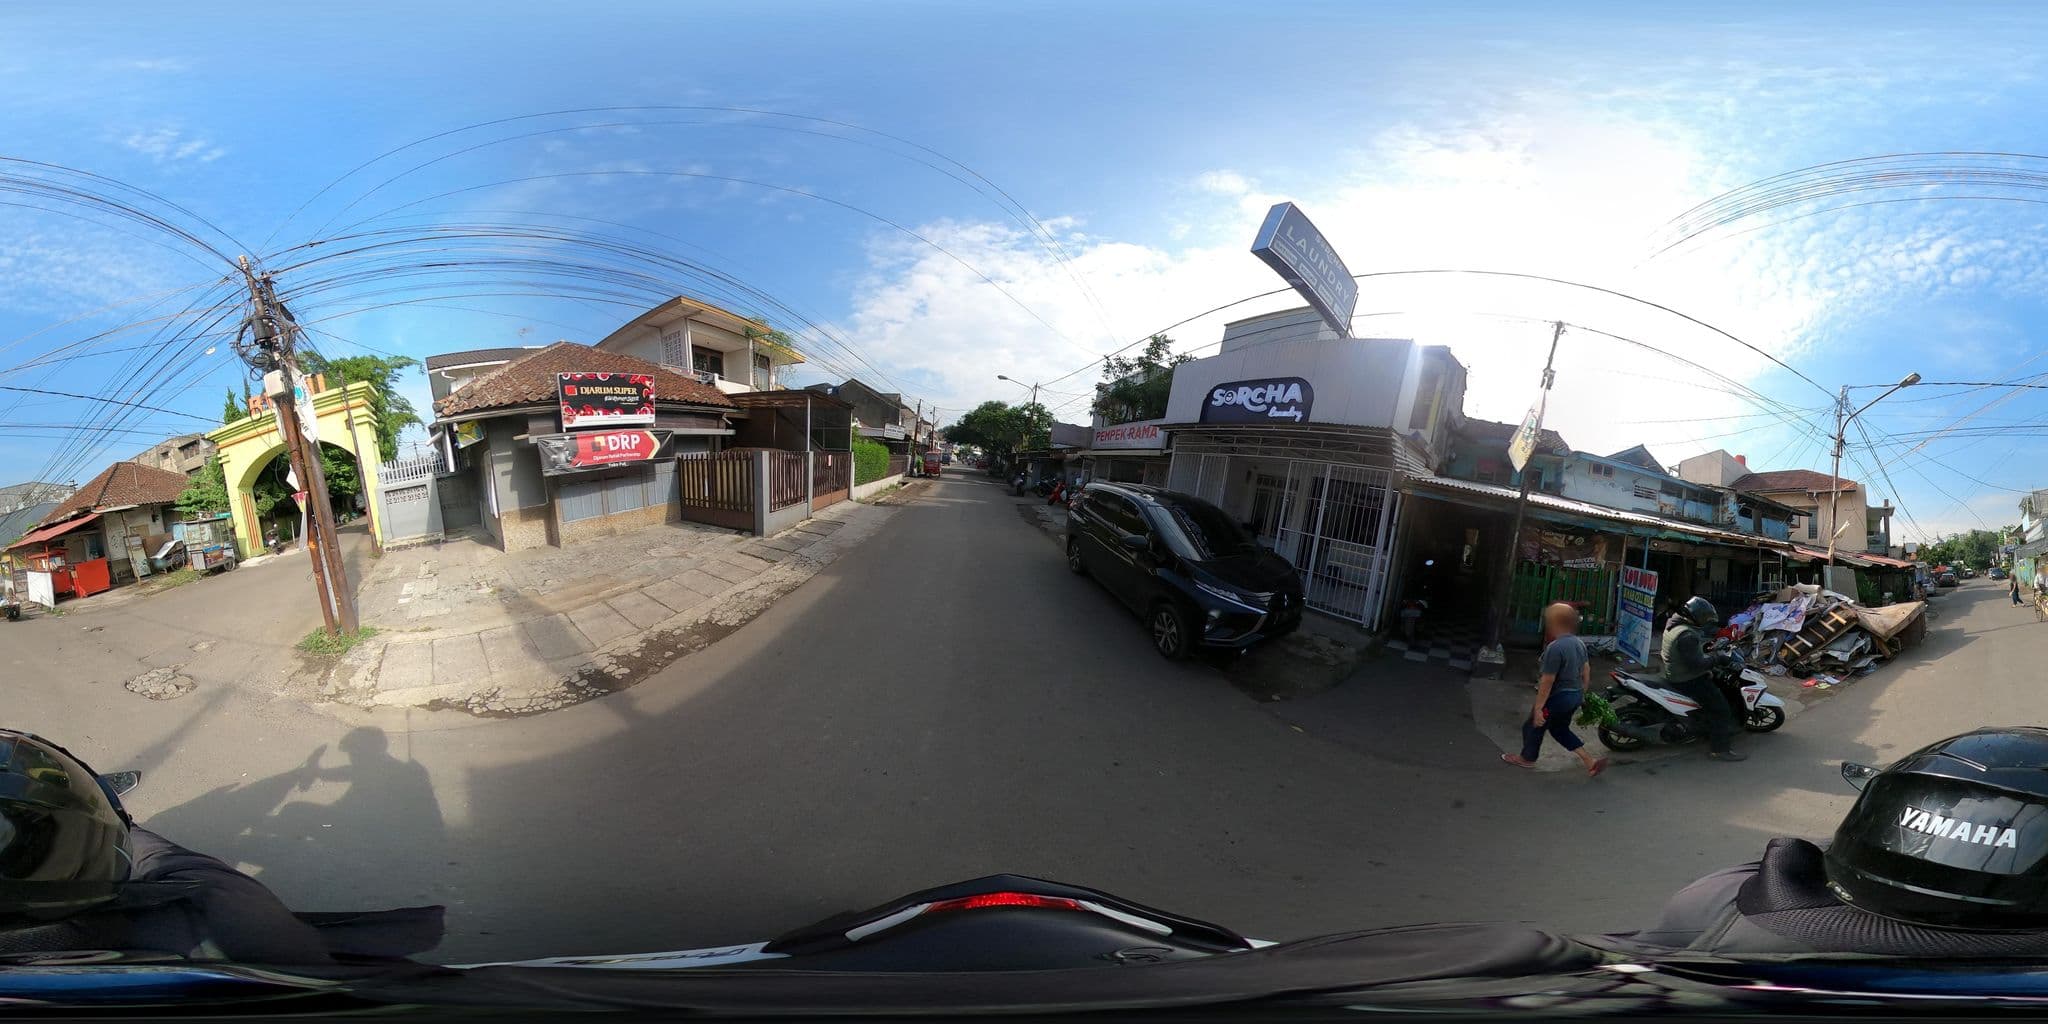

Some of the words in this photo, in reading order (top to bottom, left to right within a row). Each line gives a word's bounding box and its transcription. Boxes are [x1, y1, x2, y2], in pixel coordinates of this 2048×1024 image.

[1286, 225, 1350, 301] LAUNDRY
[580, 386, 613, 395] DJARUM
[614, 387, 638, 395] SUPER
[1212, 383, 1303, 412] SORCHA
[608, 434, 641, 451] DRP
[1095, 427, 1127, 442] PEMPEK
[1127, 425, 1158, 440] RAMA
[1901, 807, 2017, 848] YAMAHA
